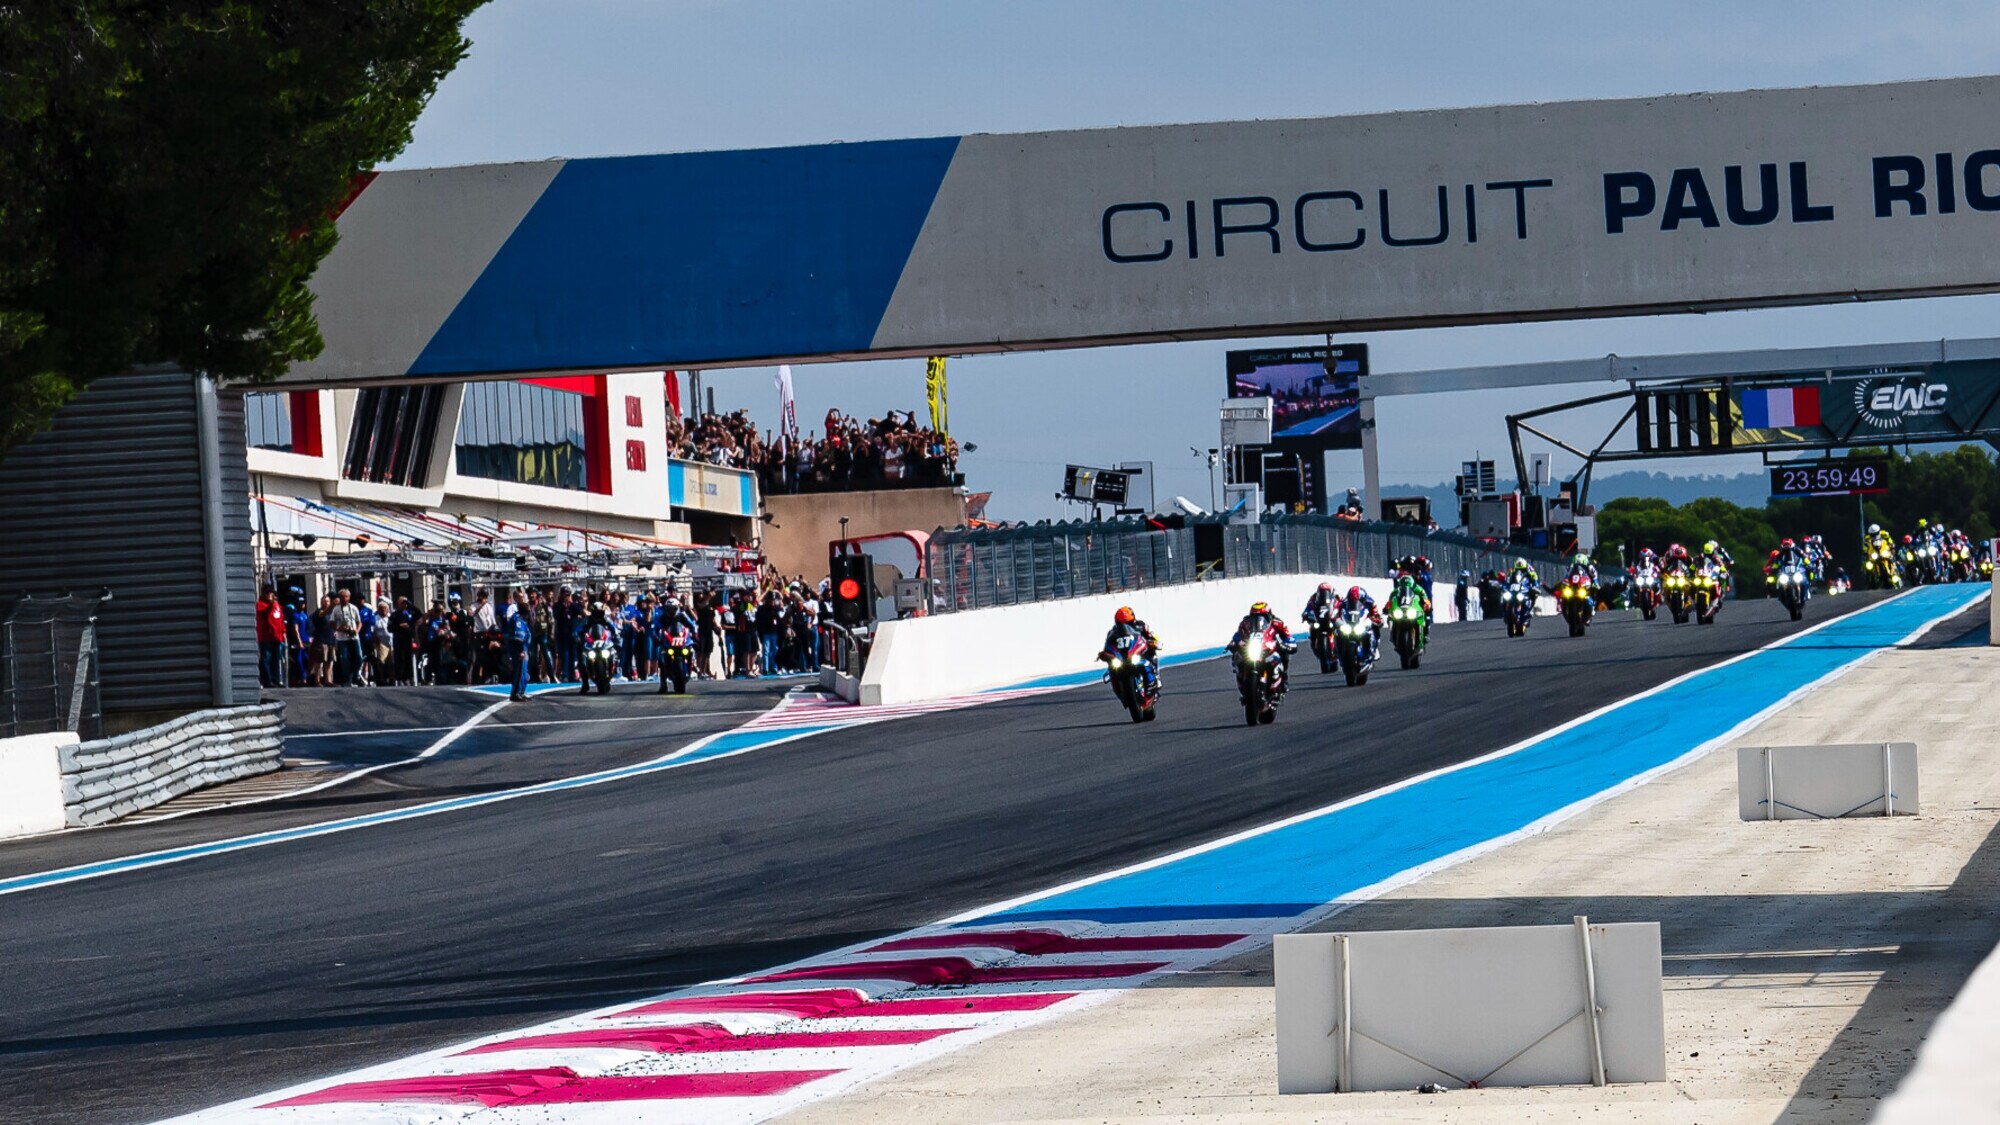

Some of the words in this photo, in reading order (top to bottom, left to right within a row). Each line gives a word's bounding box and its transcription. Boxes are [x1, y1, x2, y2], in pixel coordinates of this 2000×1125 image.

[1102, 178, 1553, 264] CIRCUIT
[1602, 161, 1835, 235] PAUL
[1291, 351, 1312, 359] PAUL
[1314, 349, 1344, 358] RICRD
[1871, 384, 1948, 411] EWC
[1783, 467, 1876, 491] 23:59:49
[1319, 608, 1328, 619] 7
[1116, 636, 1130, 649] 37
